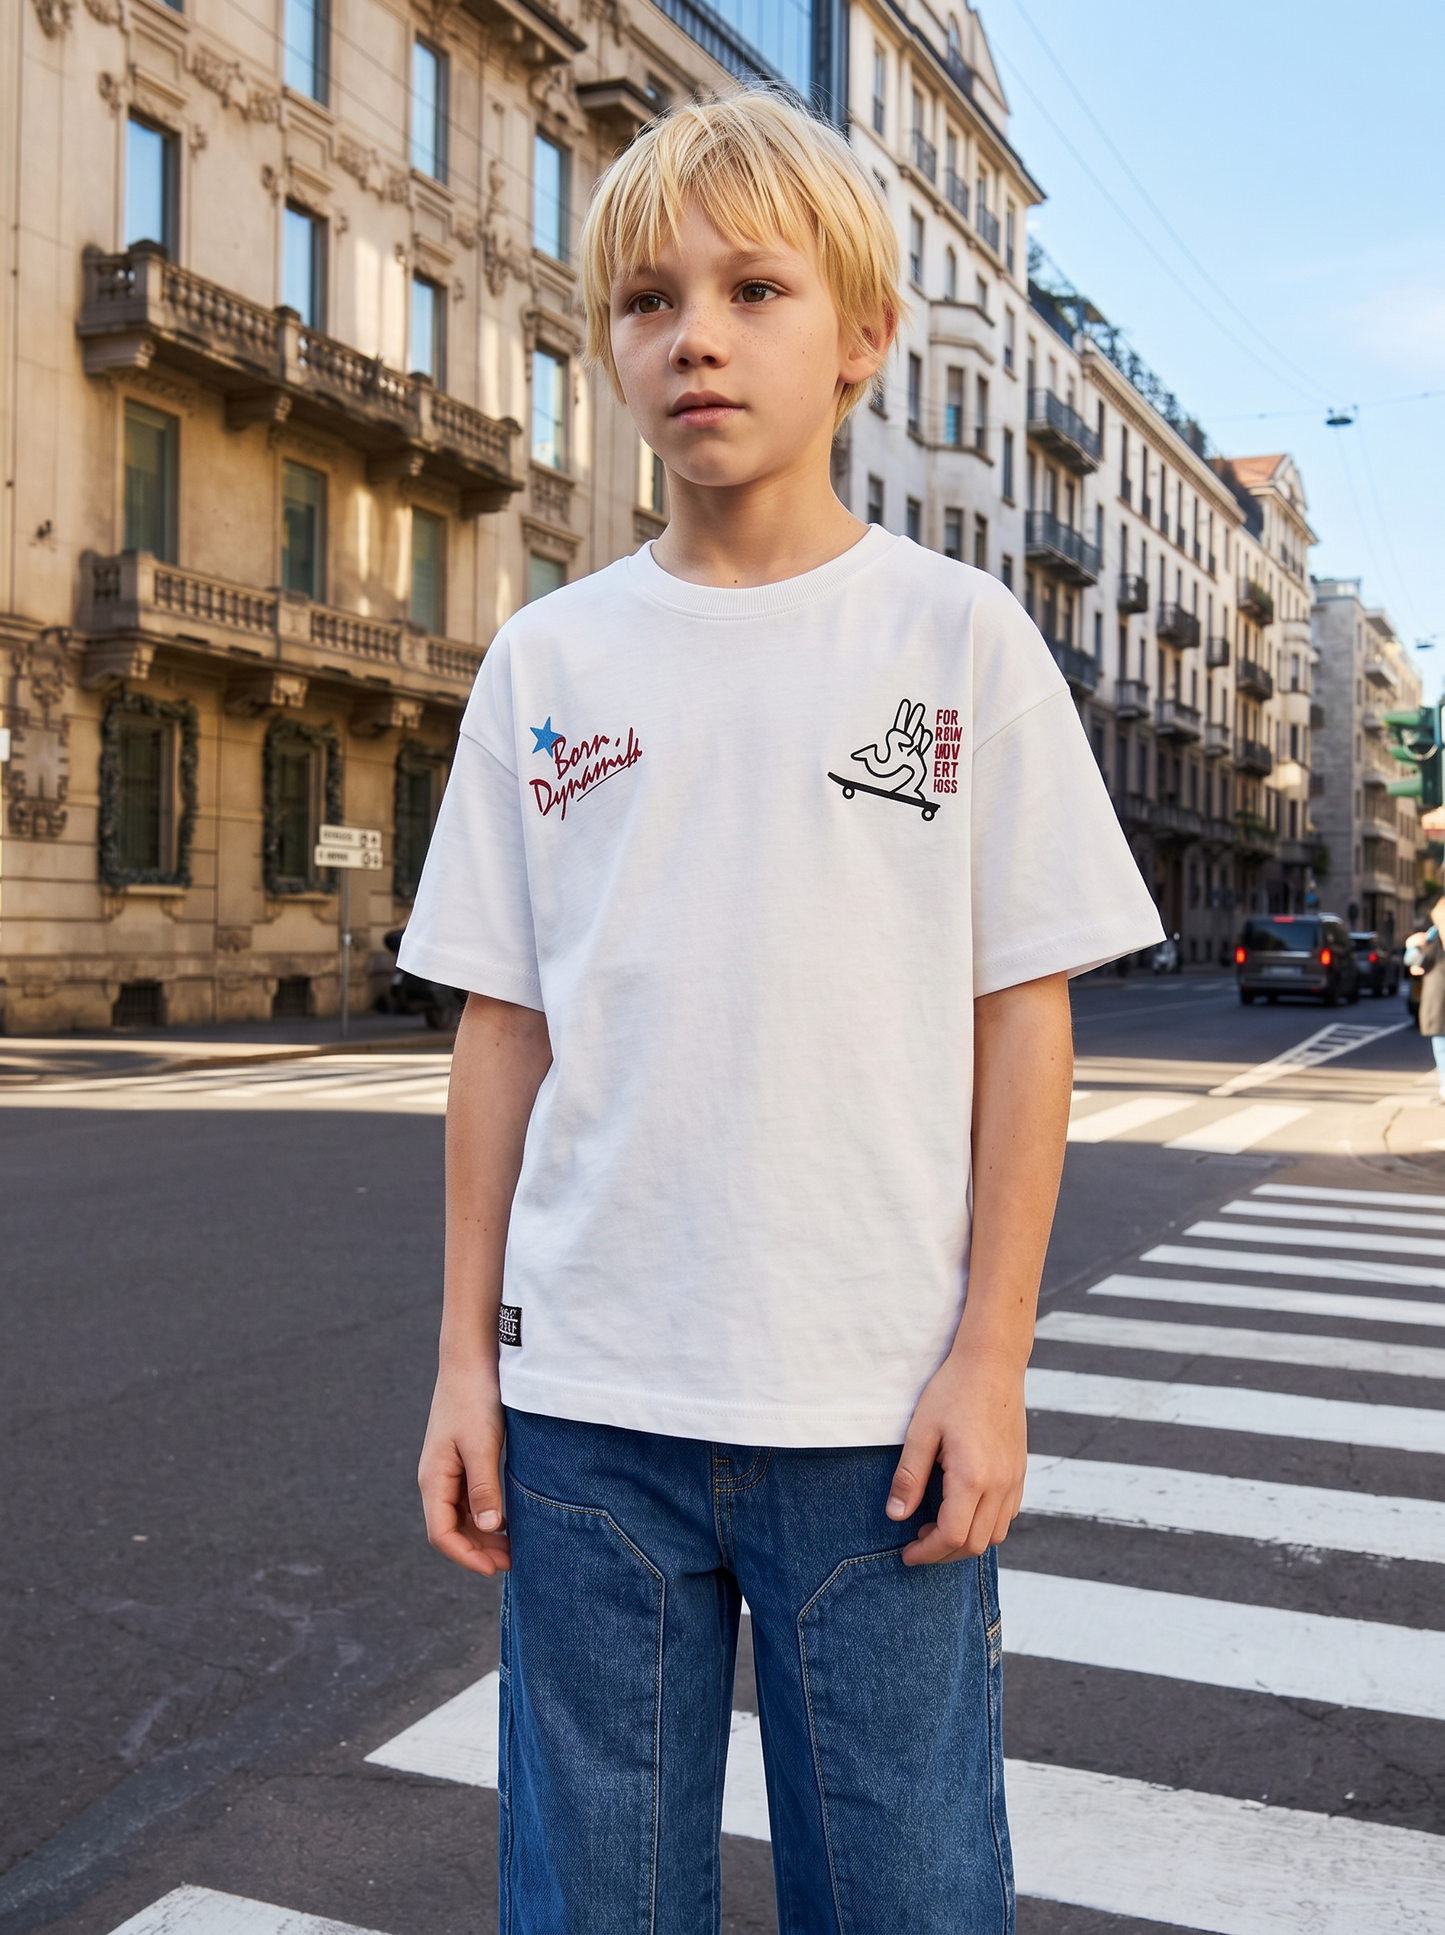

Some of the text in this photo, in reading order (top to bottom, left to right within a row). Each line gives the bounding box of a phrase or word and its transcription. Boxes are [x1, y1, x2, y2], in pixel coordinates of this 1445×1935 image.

[936, 709, 958, 726] FOR
[551, 734, 610, 780] Born
[933, 761, 959, 778] ERT
